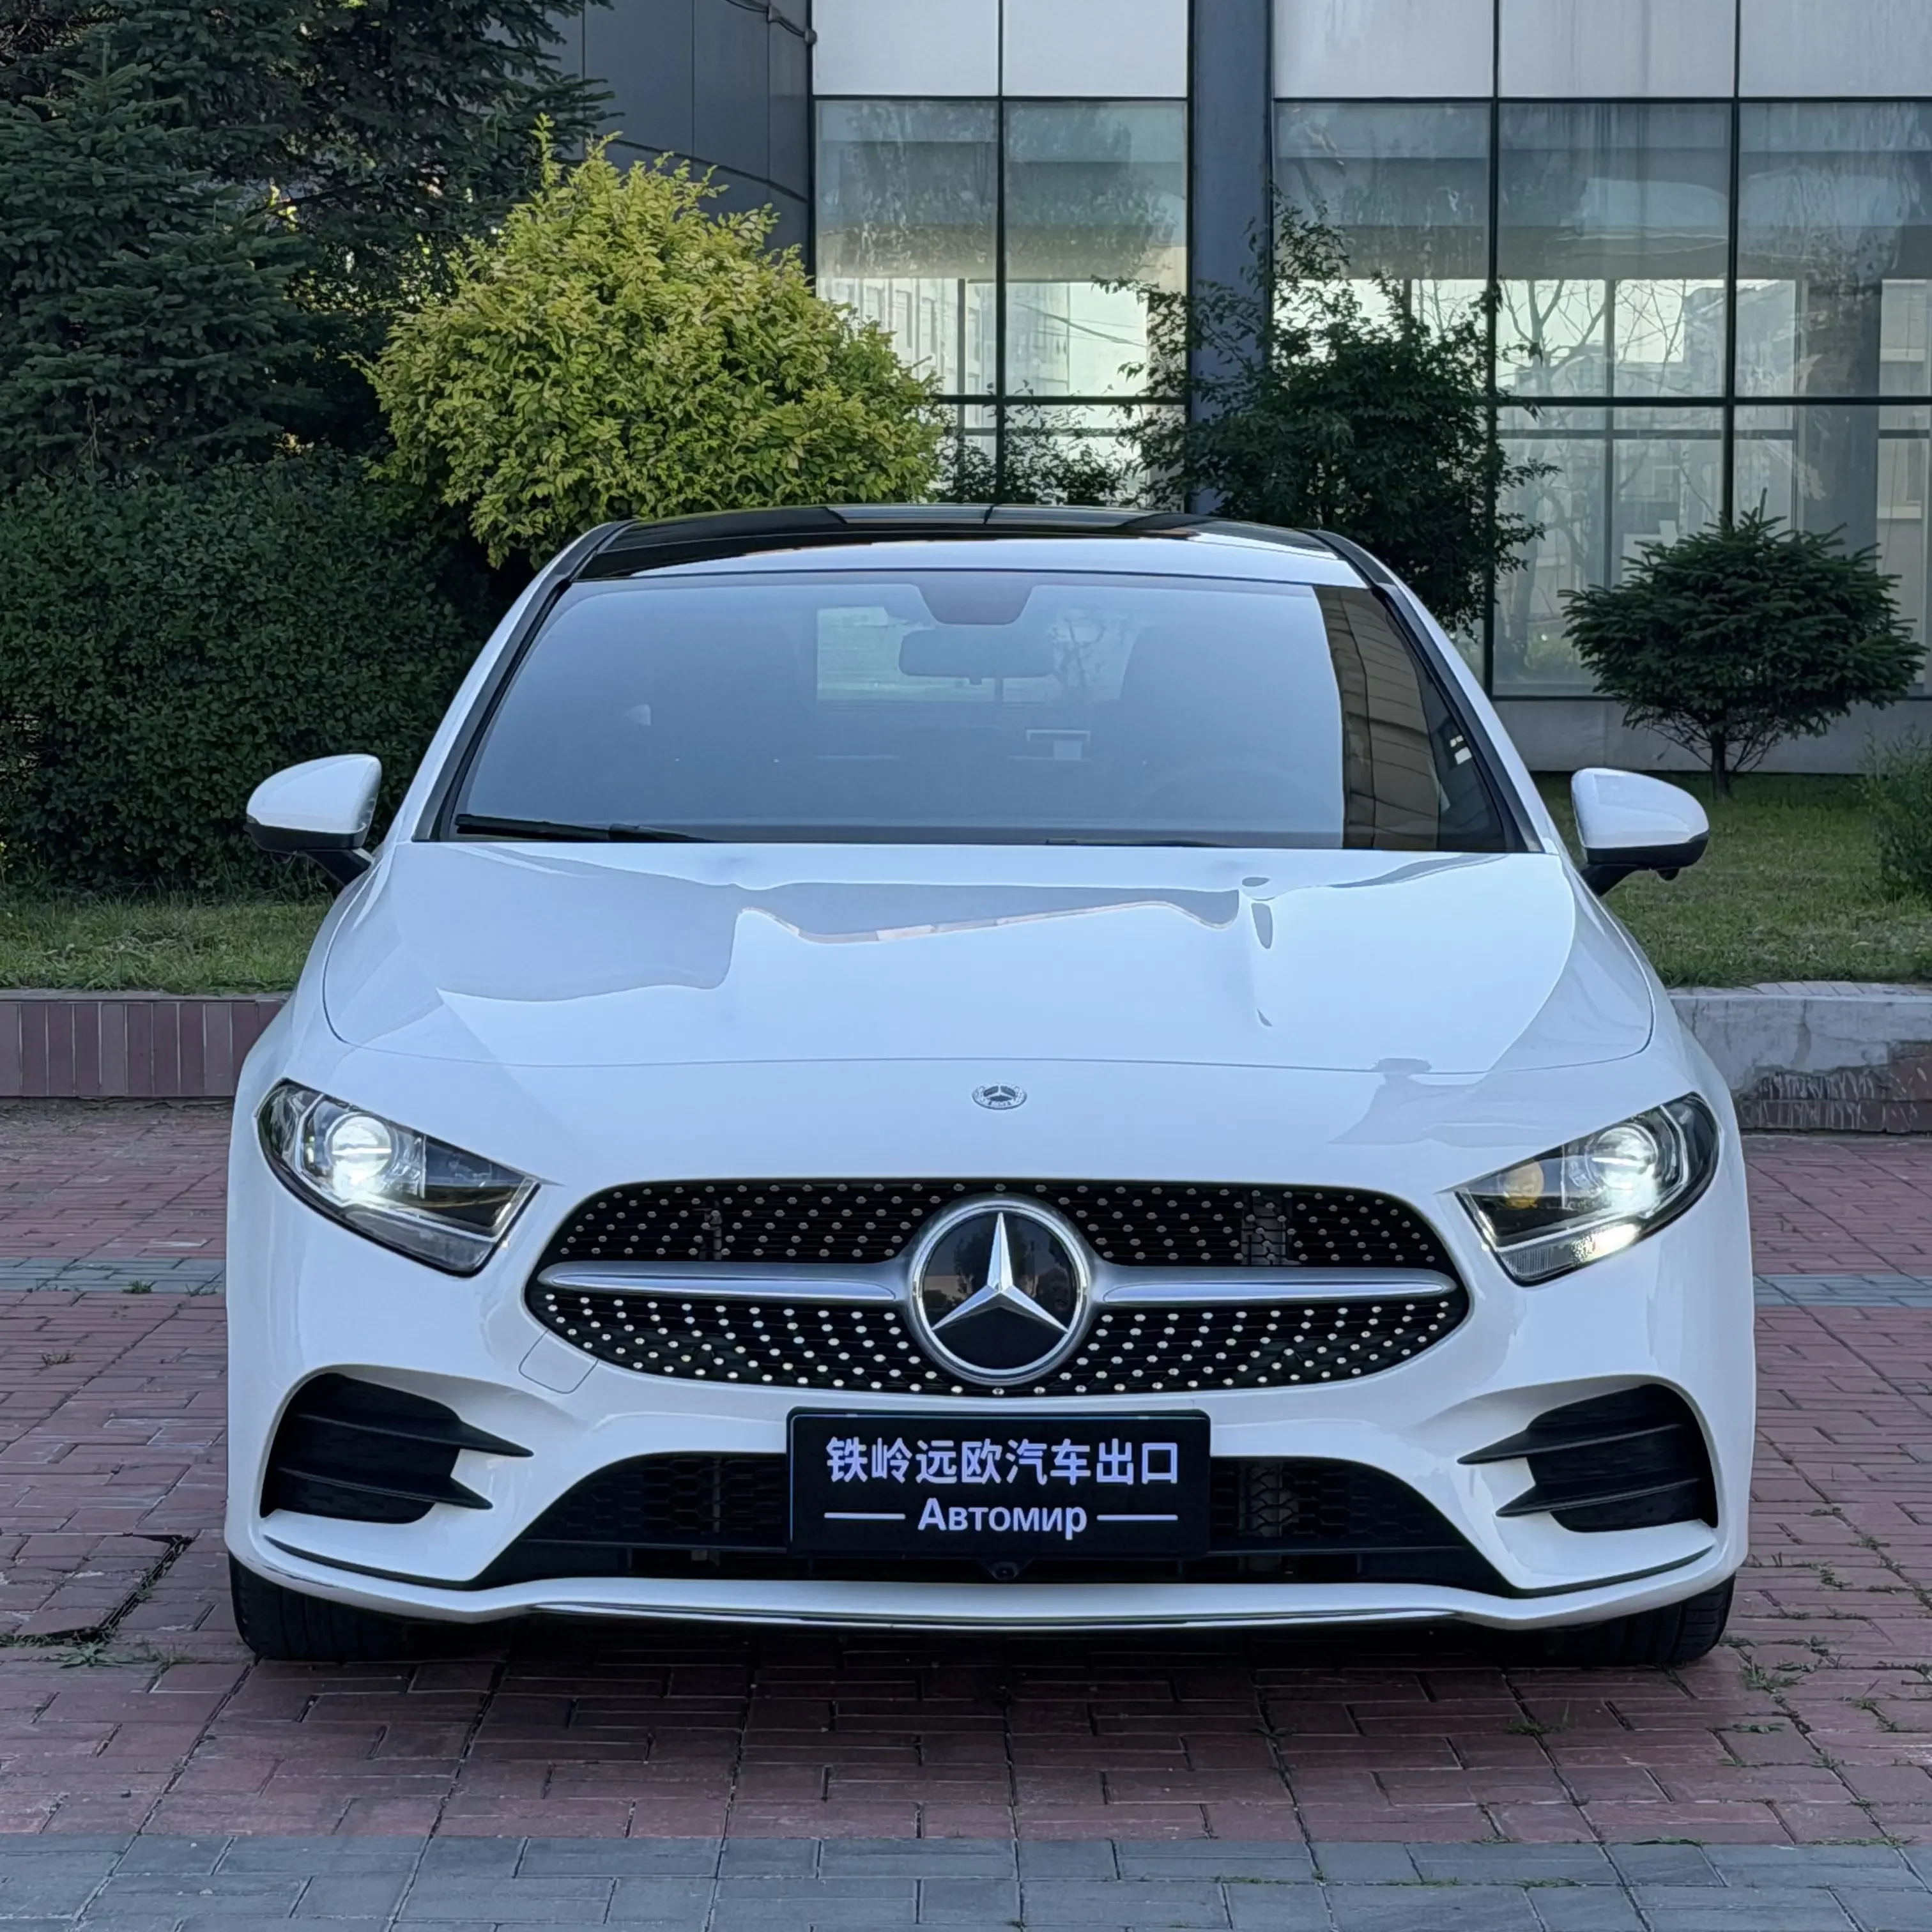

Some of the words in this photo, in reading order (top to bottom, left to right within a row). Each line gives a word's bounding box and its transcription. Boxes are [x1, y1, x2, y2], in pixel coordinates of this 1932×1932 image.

[825, 1436, 1179, 1485] 铁岭远欧汽车出口
[917, 1498, 1087, 1540] Автомир
